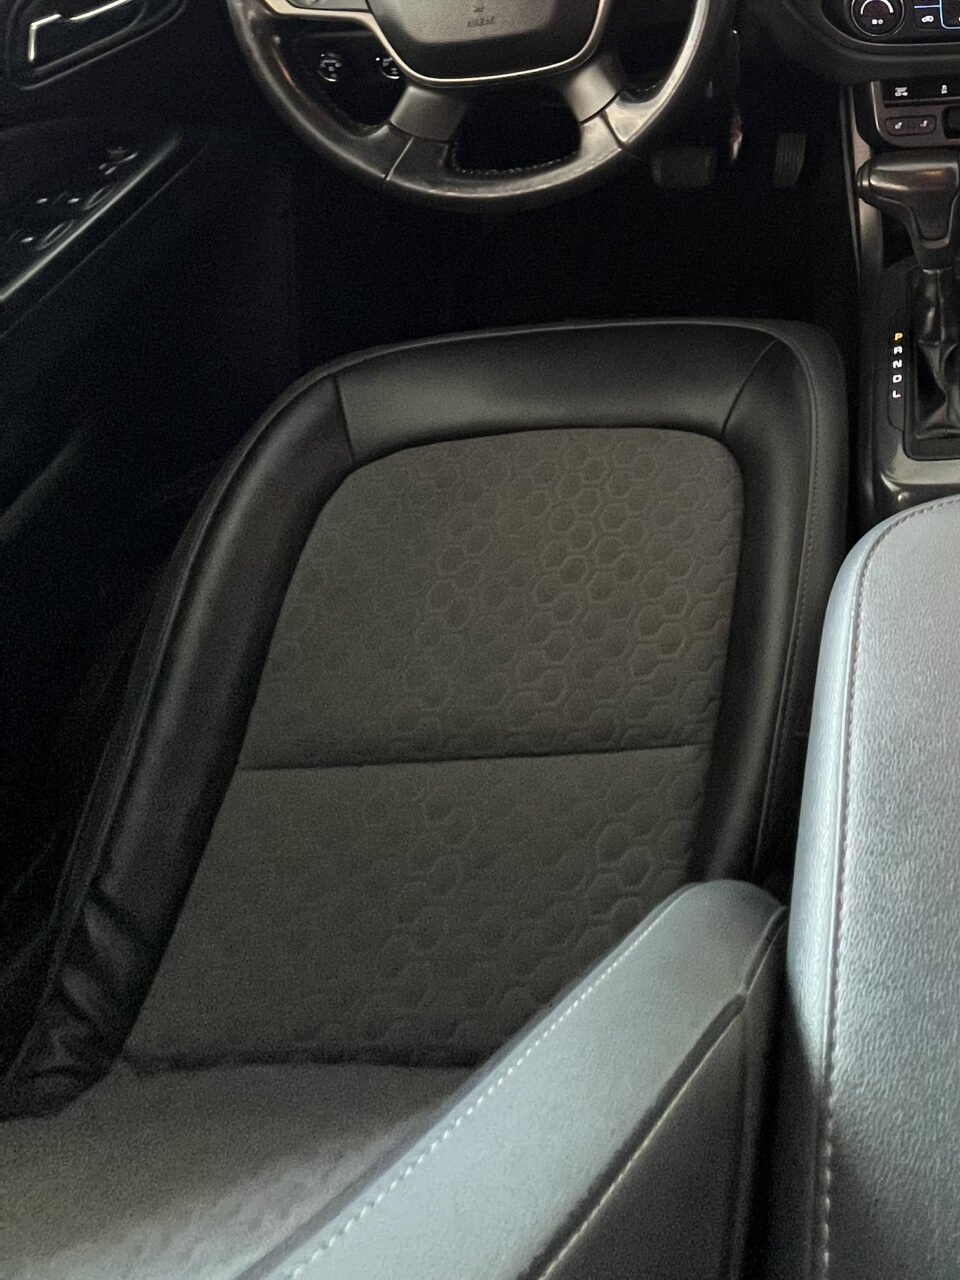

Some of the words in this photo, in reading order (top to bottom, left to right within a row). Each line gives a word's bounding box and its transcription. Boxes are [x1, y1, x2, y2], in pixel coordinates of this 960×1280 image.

[894, 332, 903, 341] P
[893, 346, 903, 355] R
[892, 359, 903, 369] N
[892, 374, 902, 383] D
[892, 390, 902, 398] L
